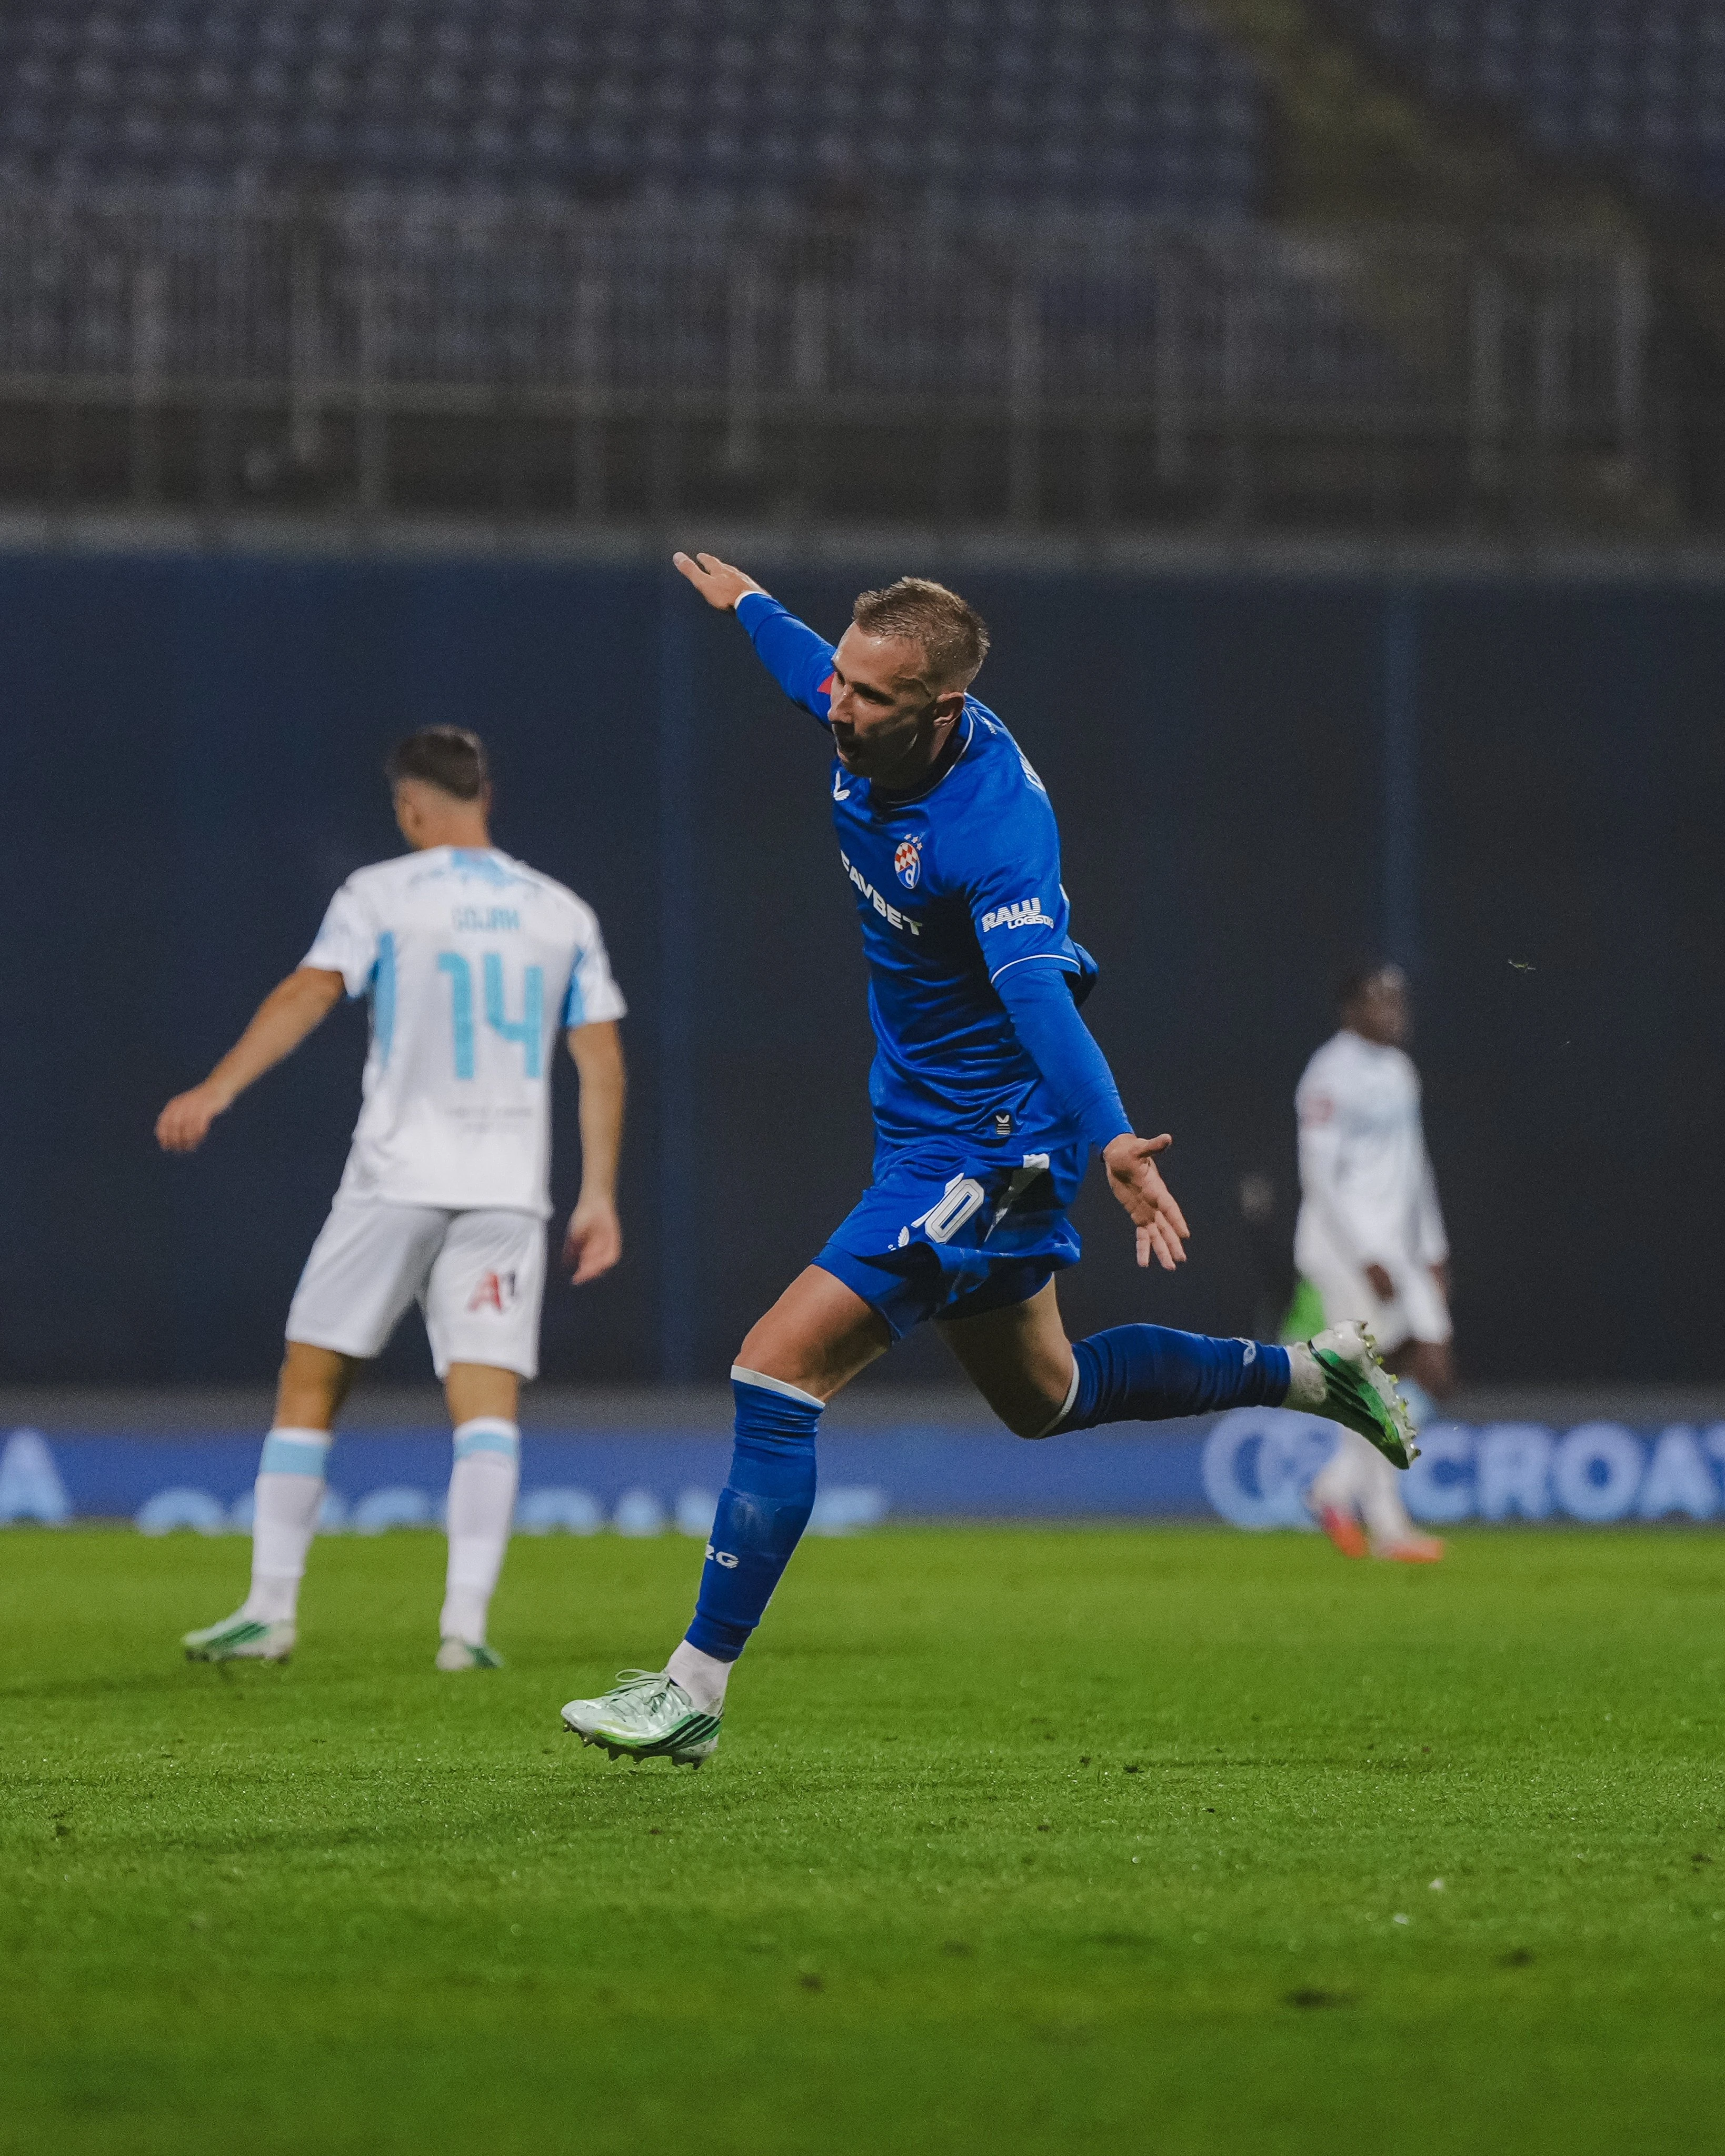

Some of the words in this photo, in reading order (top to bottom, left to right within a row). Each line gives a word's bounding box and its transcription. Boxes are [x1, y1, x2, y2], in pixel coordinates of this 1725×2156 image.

[981, 897, 1041, 933] RALU
[438, 952, 544, 1081] 14
[1399, 1421, 1725, 1523] CROA
